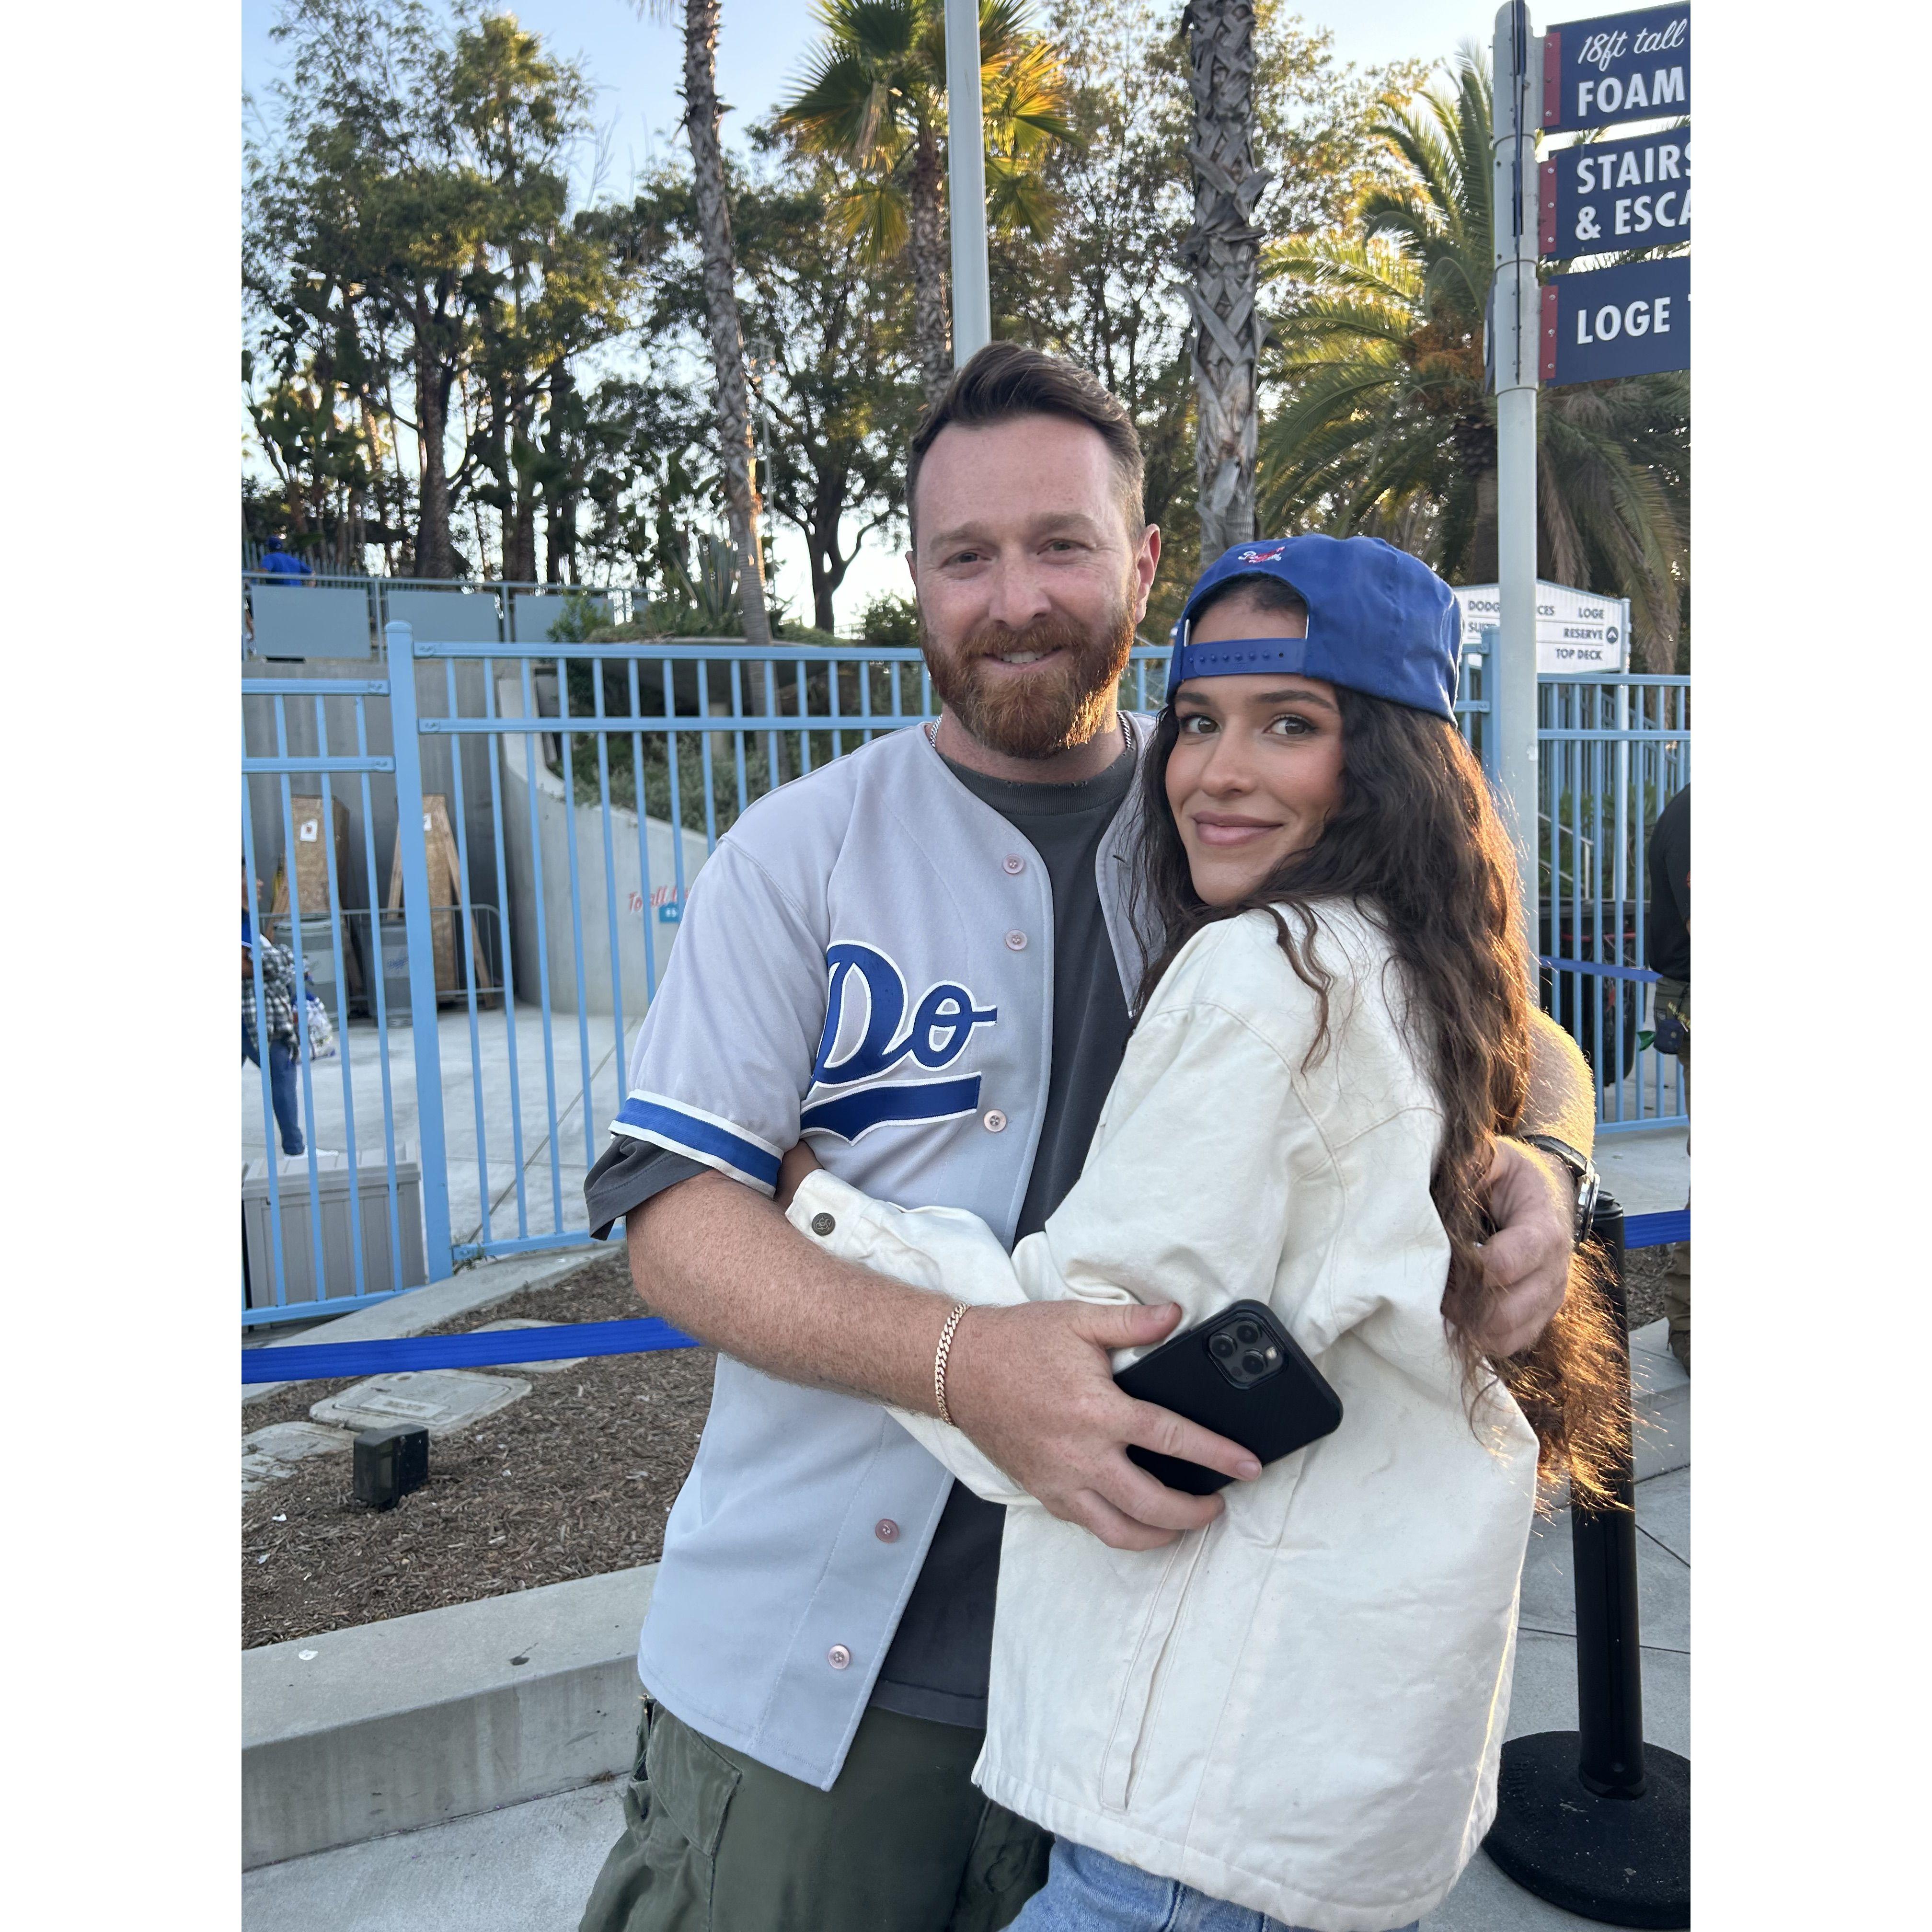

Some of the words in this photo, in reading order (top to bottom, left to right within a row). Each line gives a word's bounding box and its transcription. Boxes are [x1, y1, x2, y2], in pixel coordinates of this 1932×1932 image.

[1577, 30, 1628, 72] 18ft
[1633, 18, 1688, 54] tall
[1577, 66, 1685, 116] FOAM
[1575, 206, 1601, 241] &
[1577, 296, 1671, 345] LOGE
[1578, 607, 1604, 620] LOGE
[1564, 628, 1603, 640] RESERVE
[1556, 648, 1575, 659] TOP
[1577, 650, 1603, 661] DECK
